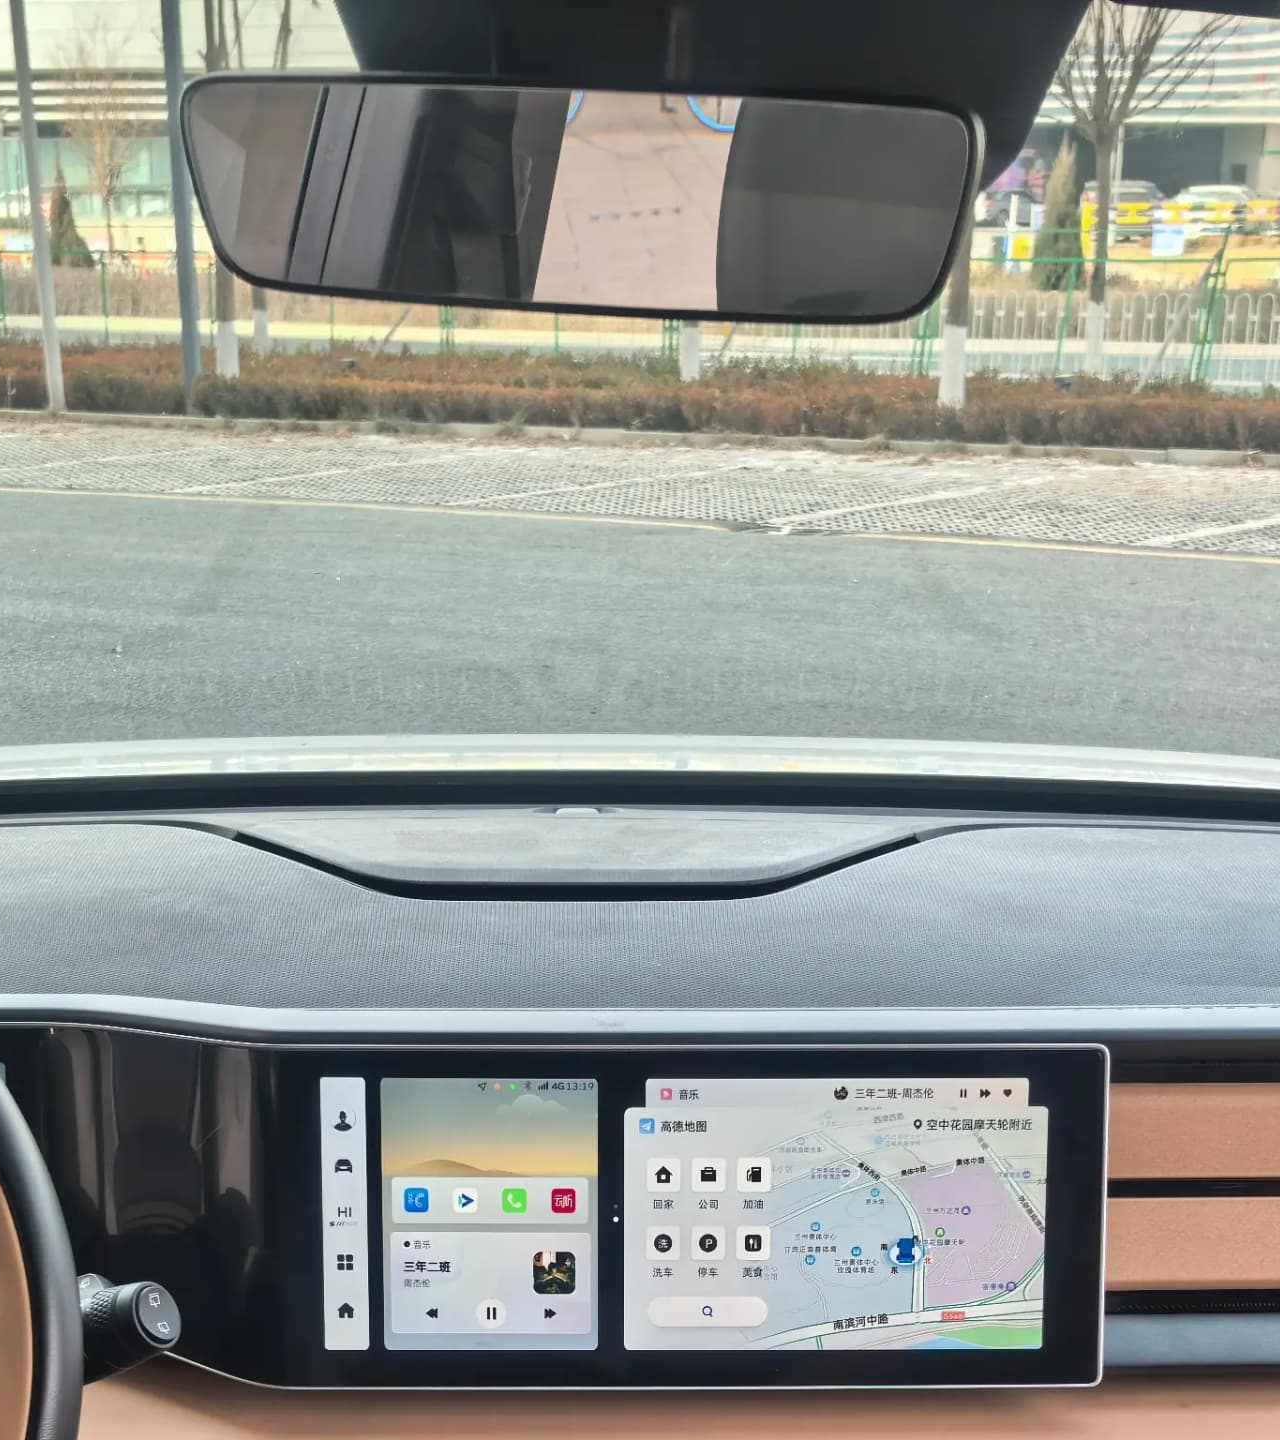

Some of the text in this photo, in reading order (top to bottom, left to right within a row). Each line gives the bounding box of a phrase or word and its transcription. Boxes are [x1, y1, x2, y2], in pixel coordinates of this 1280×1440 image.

[552, 1080, 594, 1091] 4G 13:19
[679, 1089, 699, 1100] 音乐
[854, 1088, 934, 1099] 三年二班-周杰伦
[660, 1121, 707, 1133] 高德地图
[926, 1118, 1032, 1131] 空中花园摩天轮附近
[653, 1199, 674, 1210] 回家
[698, 1199, 719, 1210] 公司
[743, 1199, 764, 1210] 加油
[338, 1207, 352, 1218] HI
[414, 1240, 431, 1250] 音乐
[403, 1261, 451, 1273] 三年二班
[652, 1267, 673, 1278] 洗车
[698, 1267, 719, 1278] 停车
[742, 1267, 764, 1278] 美食
[403, 1279, 431, 1288] 周杰伦
[833, 1313, 889, 1331] 南滨河中路
